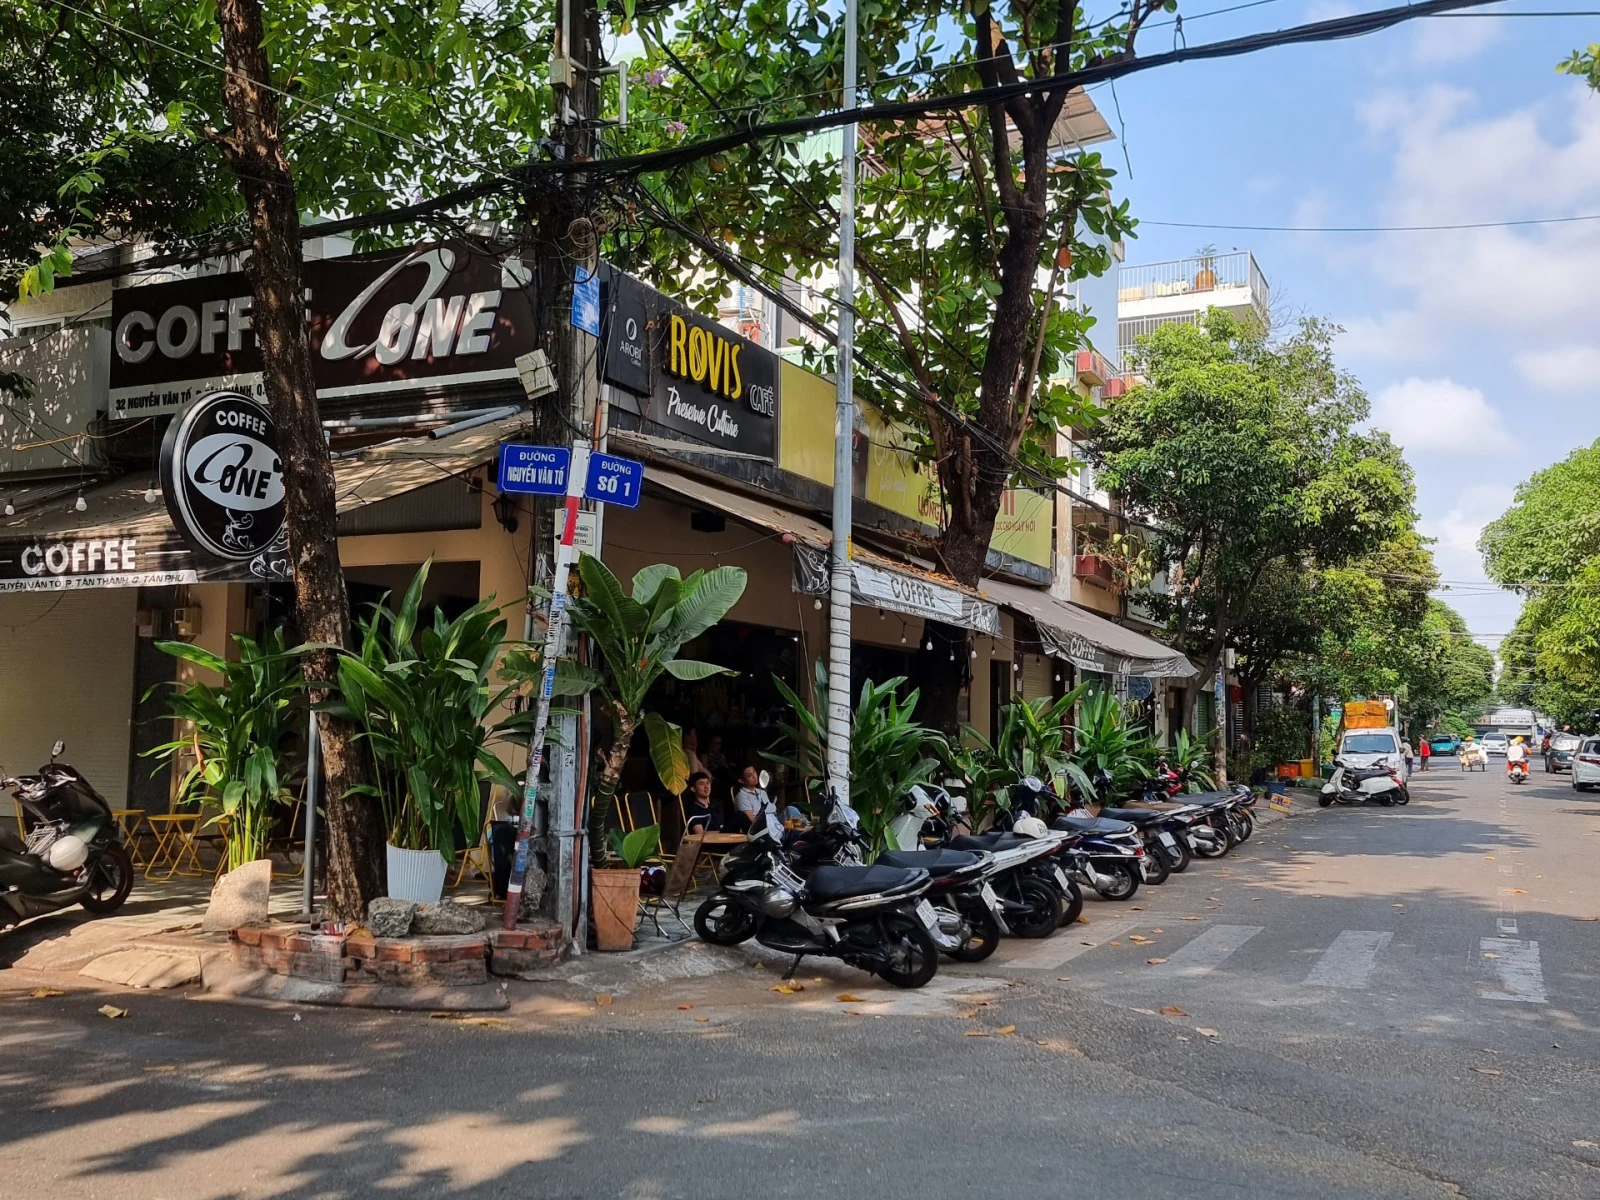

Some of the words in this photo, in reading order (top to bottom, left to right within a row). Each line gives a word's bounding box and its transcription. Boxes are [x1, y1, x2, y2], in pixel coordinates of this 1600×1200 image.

[115, 287, 311, 363] COFF
[671, 314, 742, 399] ROVIS
[115, 399, 126, 411] 32
[162, 390, 179, 406] VĂN
[667, 385, 706, 425] Preserve
[707, 404, 739, 438] Culture
[750, 384, 774, 417] CAFÉ
[215, 410, 267, 436] COFFEE
[519, 451, 556, 462] ĐƯỜNG
[601, 460, 632, 475] ĐƯỜNG
[507, 463, 537, 483] NGUYỄN
[538, 466, 553, 485] VĂN
[554, 465, 565, 486] TỐ
[597, 474, 619, 494] SỐ
[624, 482, 631, 497] 1
[20, 539, 136, 575] COFFEE
[890, 575, 936, 608] COFFEE
